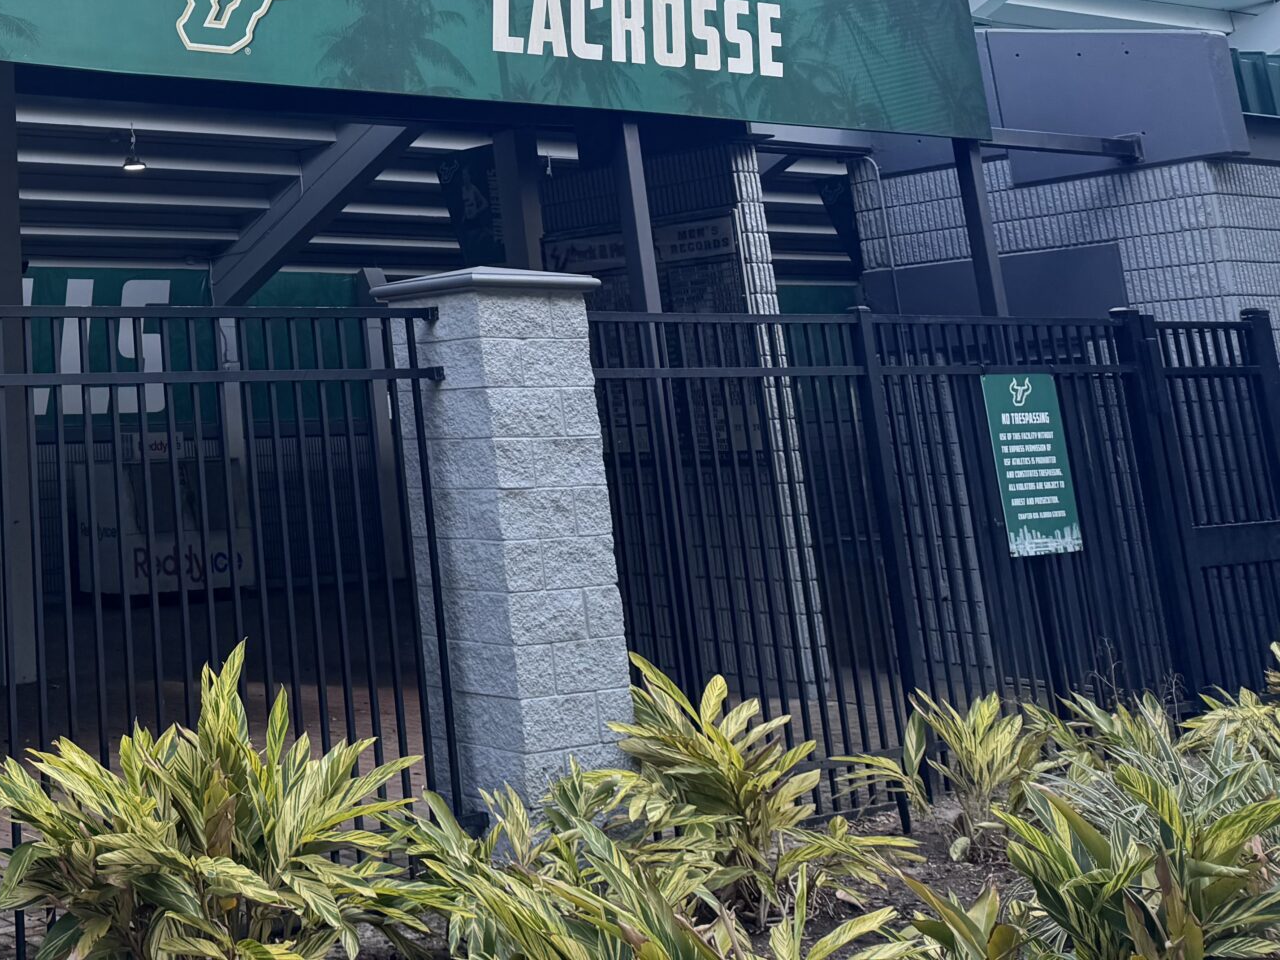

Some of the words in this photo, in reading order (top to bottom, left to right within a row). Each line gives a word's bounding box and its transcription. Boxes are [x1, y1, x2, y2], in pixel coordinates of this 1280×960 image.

[670, 237, 729, 253] RECORDS
[1001, 413, 1010, 424] NO
[1010, 412, 1050, 424] TRESPASSING
